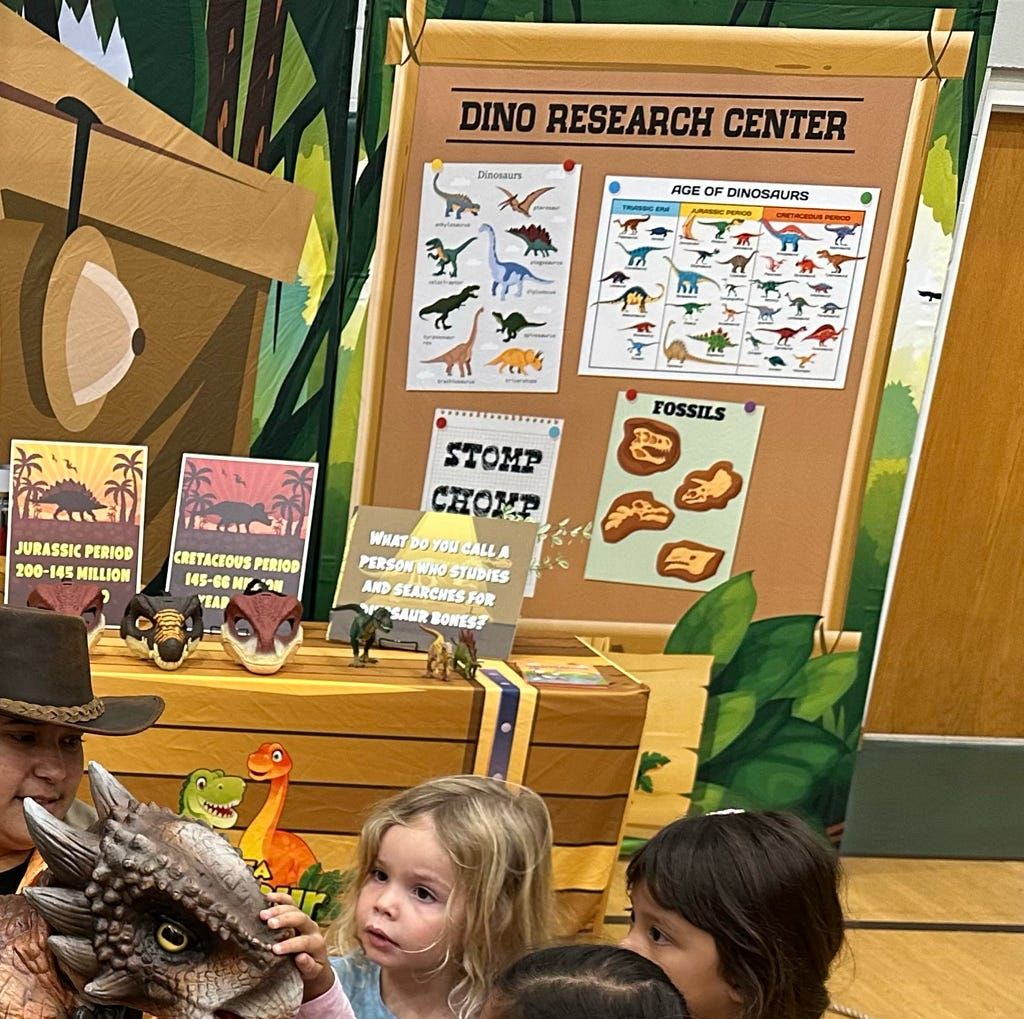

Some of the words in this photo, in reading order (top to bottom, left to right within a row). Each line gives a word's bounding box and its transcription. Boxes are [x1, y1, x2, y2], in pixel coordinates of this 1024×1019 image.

[459, 101, 537, 132] DINO
[546, 103, 715, 137] RESEARCH
[723, 107, 848, 141] CENTER
[477, 170, 523, 180] Dinosaurs
[671, 185, 701, 196] AGE
[704, 186, 724, 197] OF
[727, 187, 810, 201] DINOSAURS
[652, 400, 726, 421] FOSSILS
[444, 442, 543, 474] STOMP
[431, 485, 540, 519] CHOMP
[15, 541, 82, 558] JURASSIC
[84, 544, 134, 560] PERIOD
[410, 537, 430, 551] DO
[432, 539, 459, 554] YOU
[462, 543, 496, 558] CALL
[498, 545, 510, 559] A
[16, 563, 74, 579] 200-145
[76, 566, 131, 582] MILLION
[174, 551, 251, 570] CRETACEOUS
[253, 557, 301, 574] PERIOD
[359, 555, 414, 573] PERSON
[415, 563, 447, 577] WHO
[449, 566, 511, 584] STUDIES
[185, 572, 230, 589] 145-66
[198, 594, 230, 609] YEAR
[362, 580, 391, 595] AND
[393, 583, 465, 603] SEARCHES
[466, 592, 496, 607] FOR
[430, 611, 488, 630] BONES?
